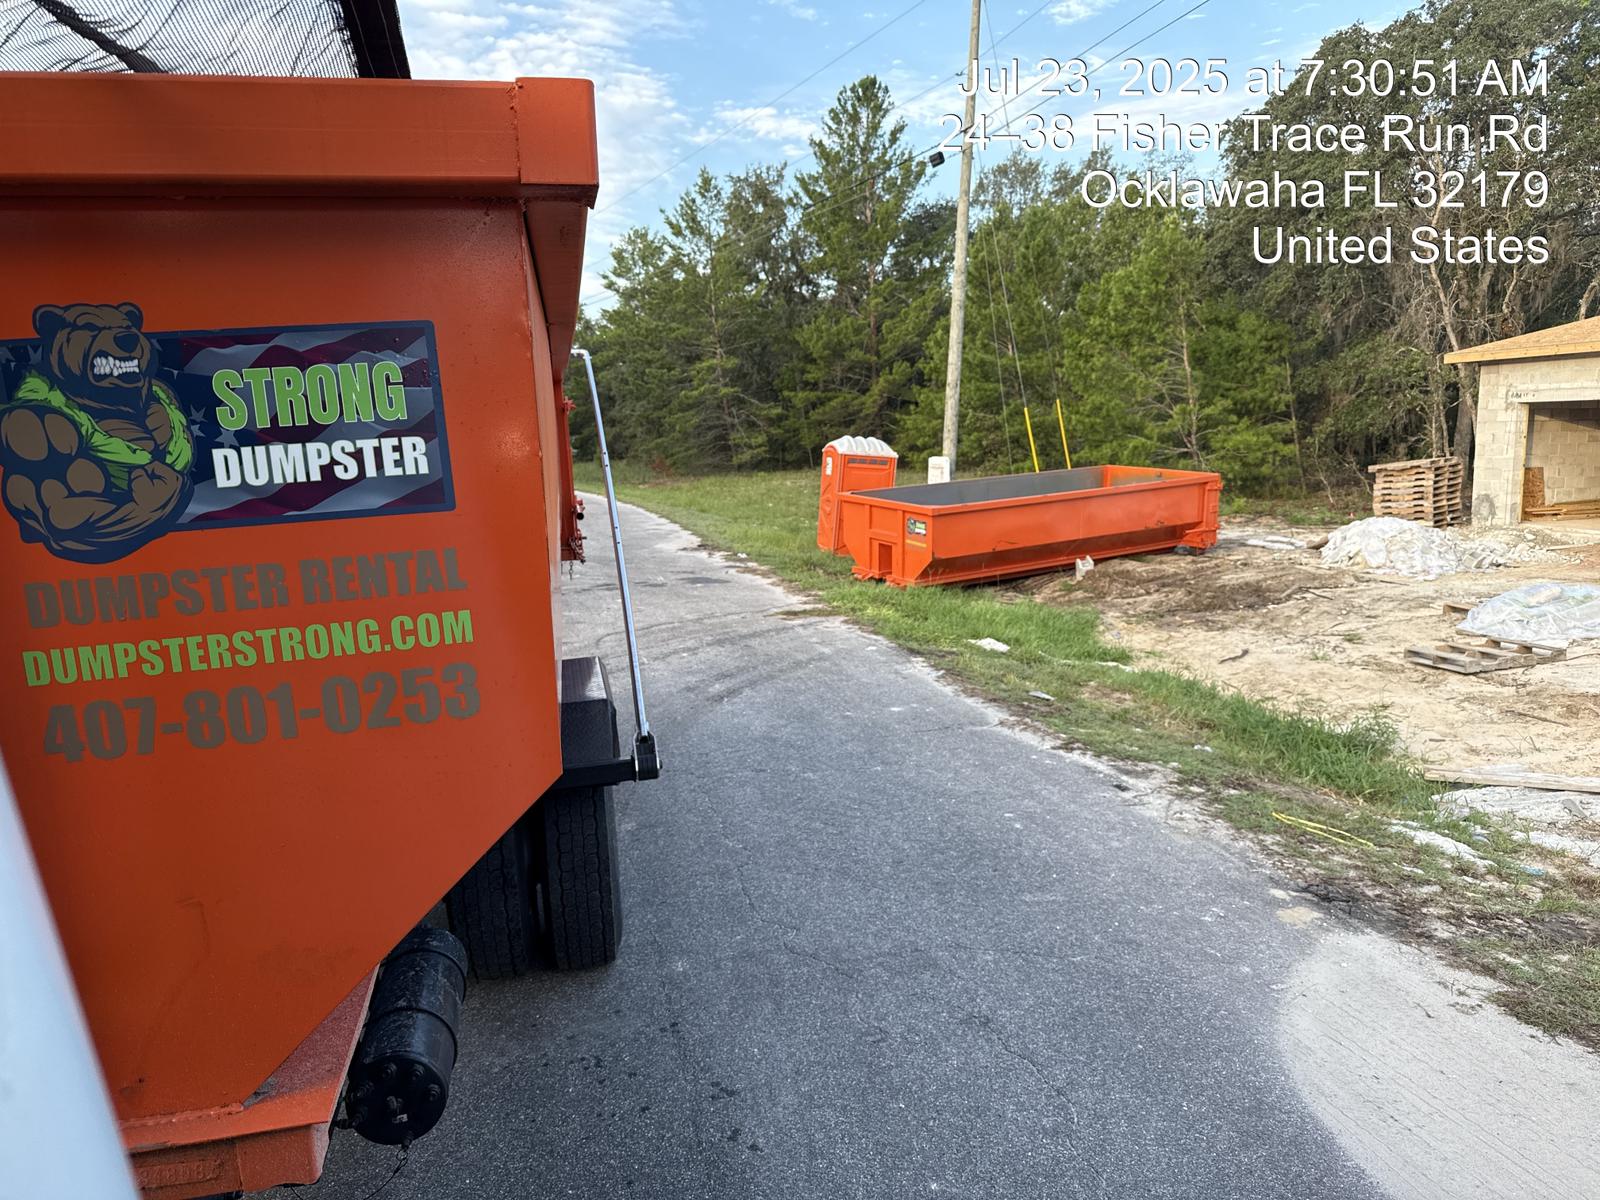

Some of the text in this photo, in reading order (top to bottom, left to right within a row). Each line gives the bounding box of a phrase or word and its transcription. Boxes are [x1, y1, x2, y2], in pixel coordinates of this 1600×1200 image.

[212, 361, 408, 431] STRONG
[212, 436, 430, 488] DUMPSTER
[23, 547, 468, 630] DUMPSTER RENTAL
[22, 609, 474, 687] DUMPSTERSTRONG.COM
[43, 661, 482, 764] 407-801-0253
